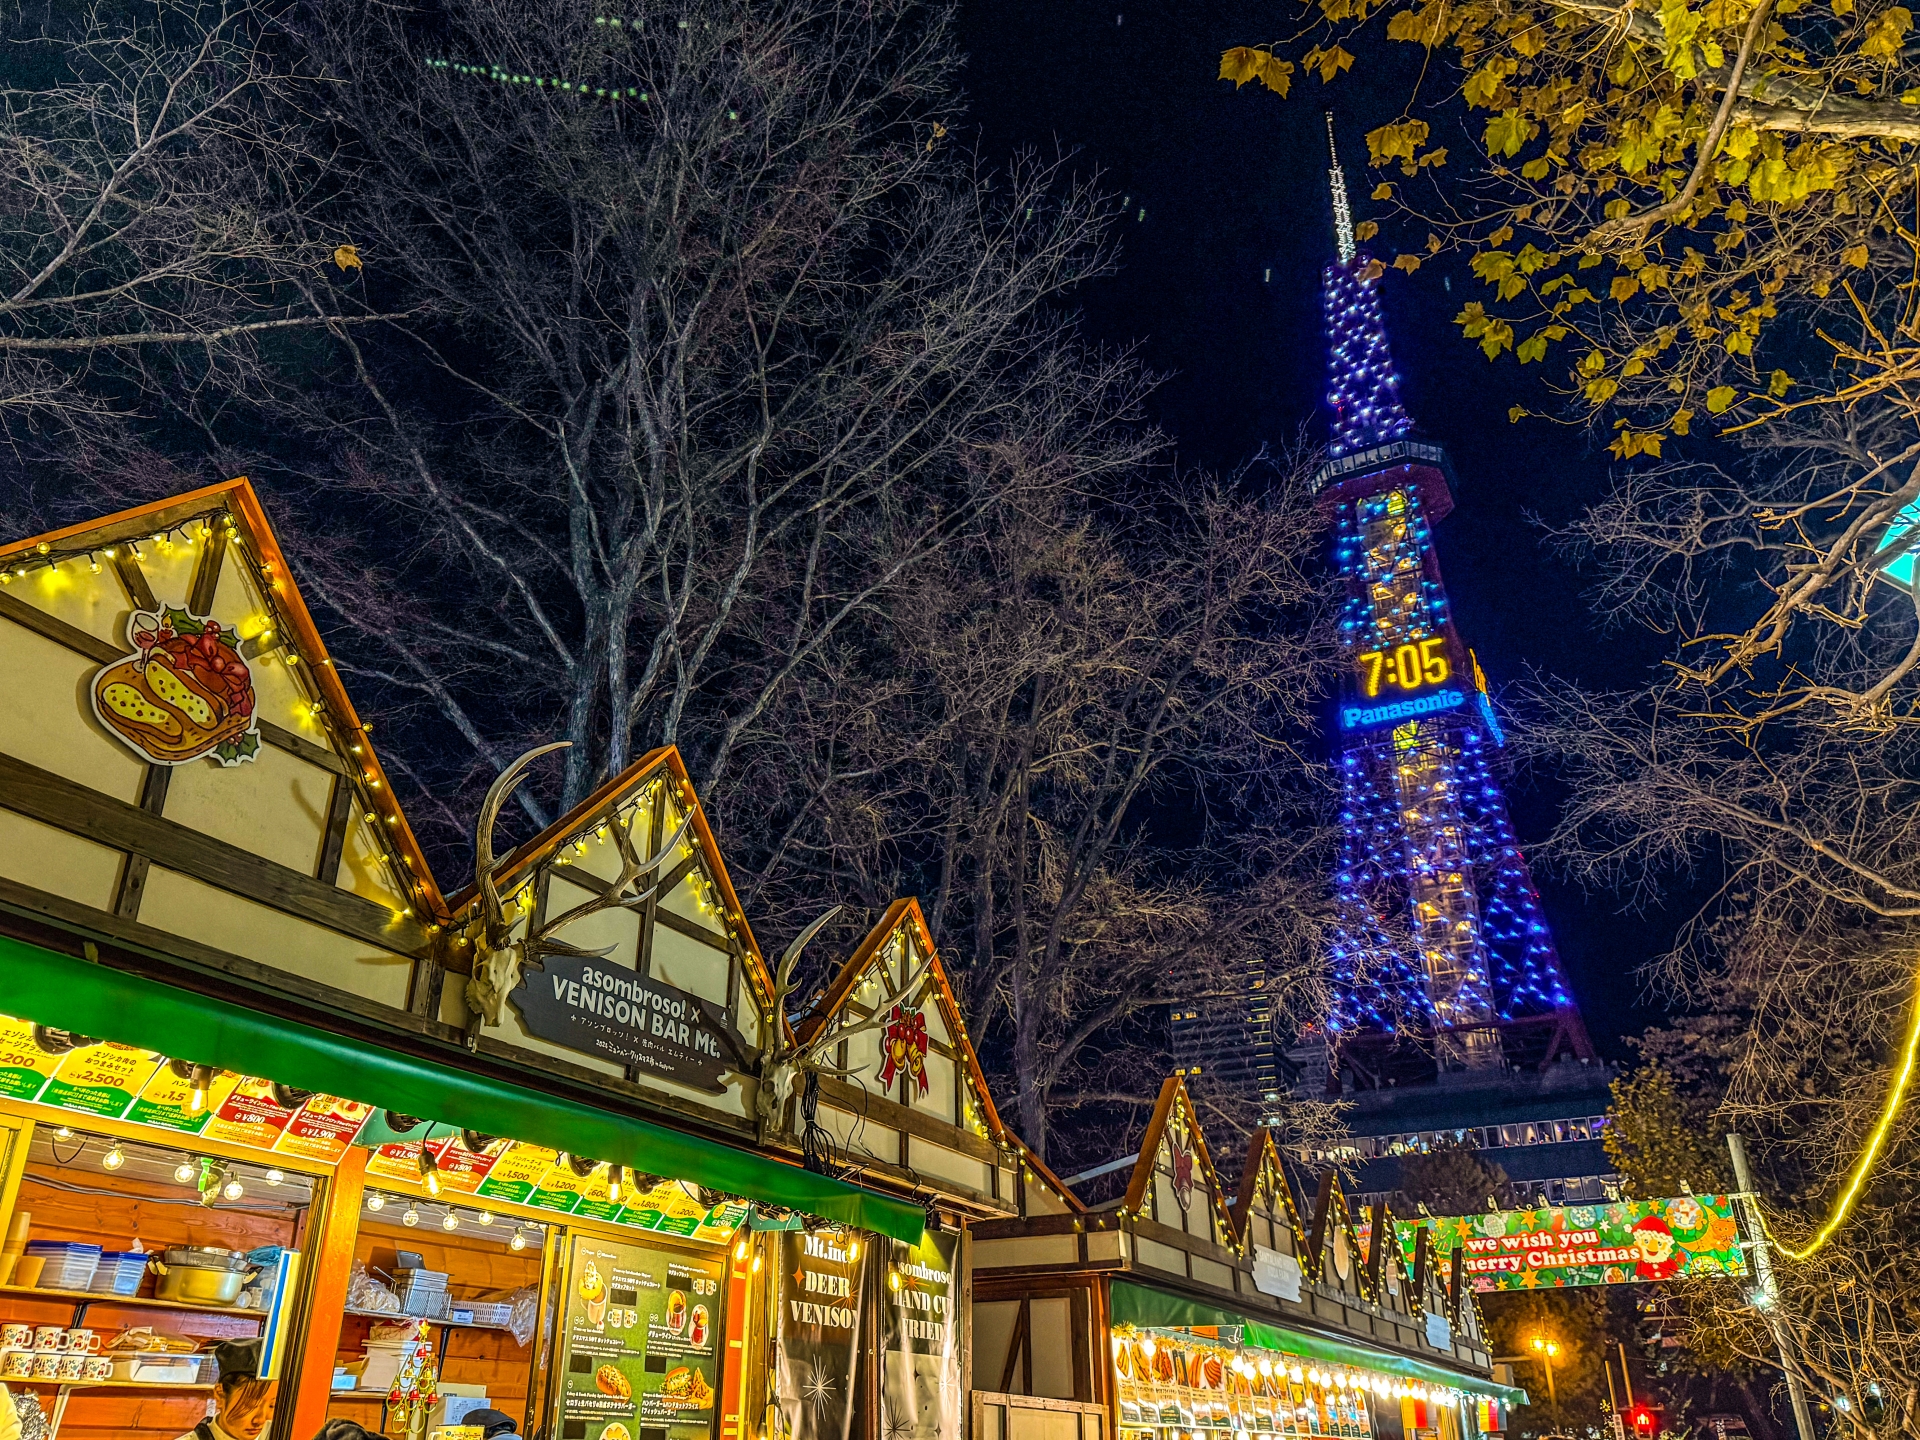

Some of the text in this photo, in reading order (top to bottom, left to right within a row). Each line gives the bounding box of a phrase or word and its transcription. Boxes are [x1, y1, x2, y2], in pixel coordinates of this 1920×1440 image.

[1360, 638, 1449, 698] 7:05
[1343, 689, 1464, 728] Panasonic
[582, 966, 687, 1020] asombroso!
[552, 974, 721, 1059] VENISON BAR Mt.
[84, 1057, 135, 1074] おつまみセット
[76, 1070, 125, 1087] ¥2,500
[161, 1090, 187, 1102] ¥1,5
[1467, 1231, 1598, 1252] we wish you
[1527, 1247, 1641, 1268] Christmas
[805, 1270, 850, 1298] DEER
[898, 1261, 952, 1285] sombroso
